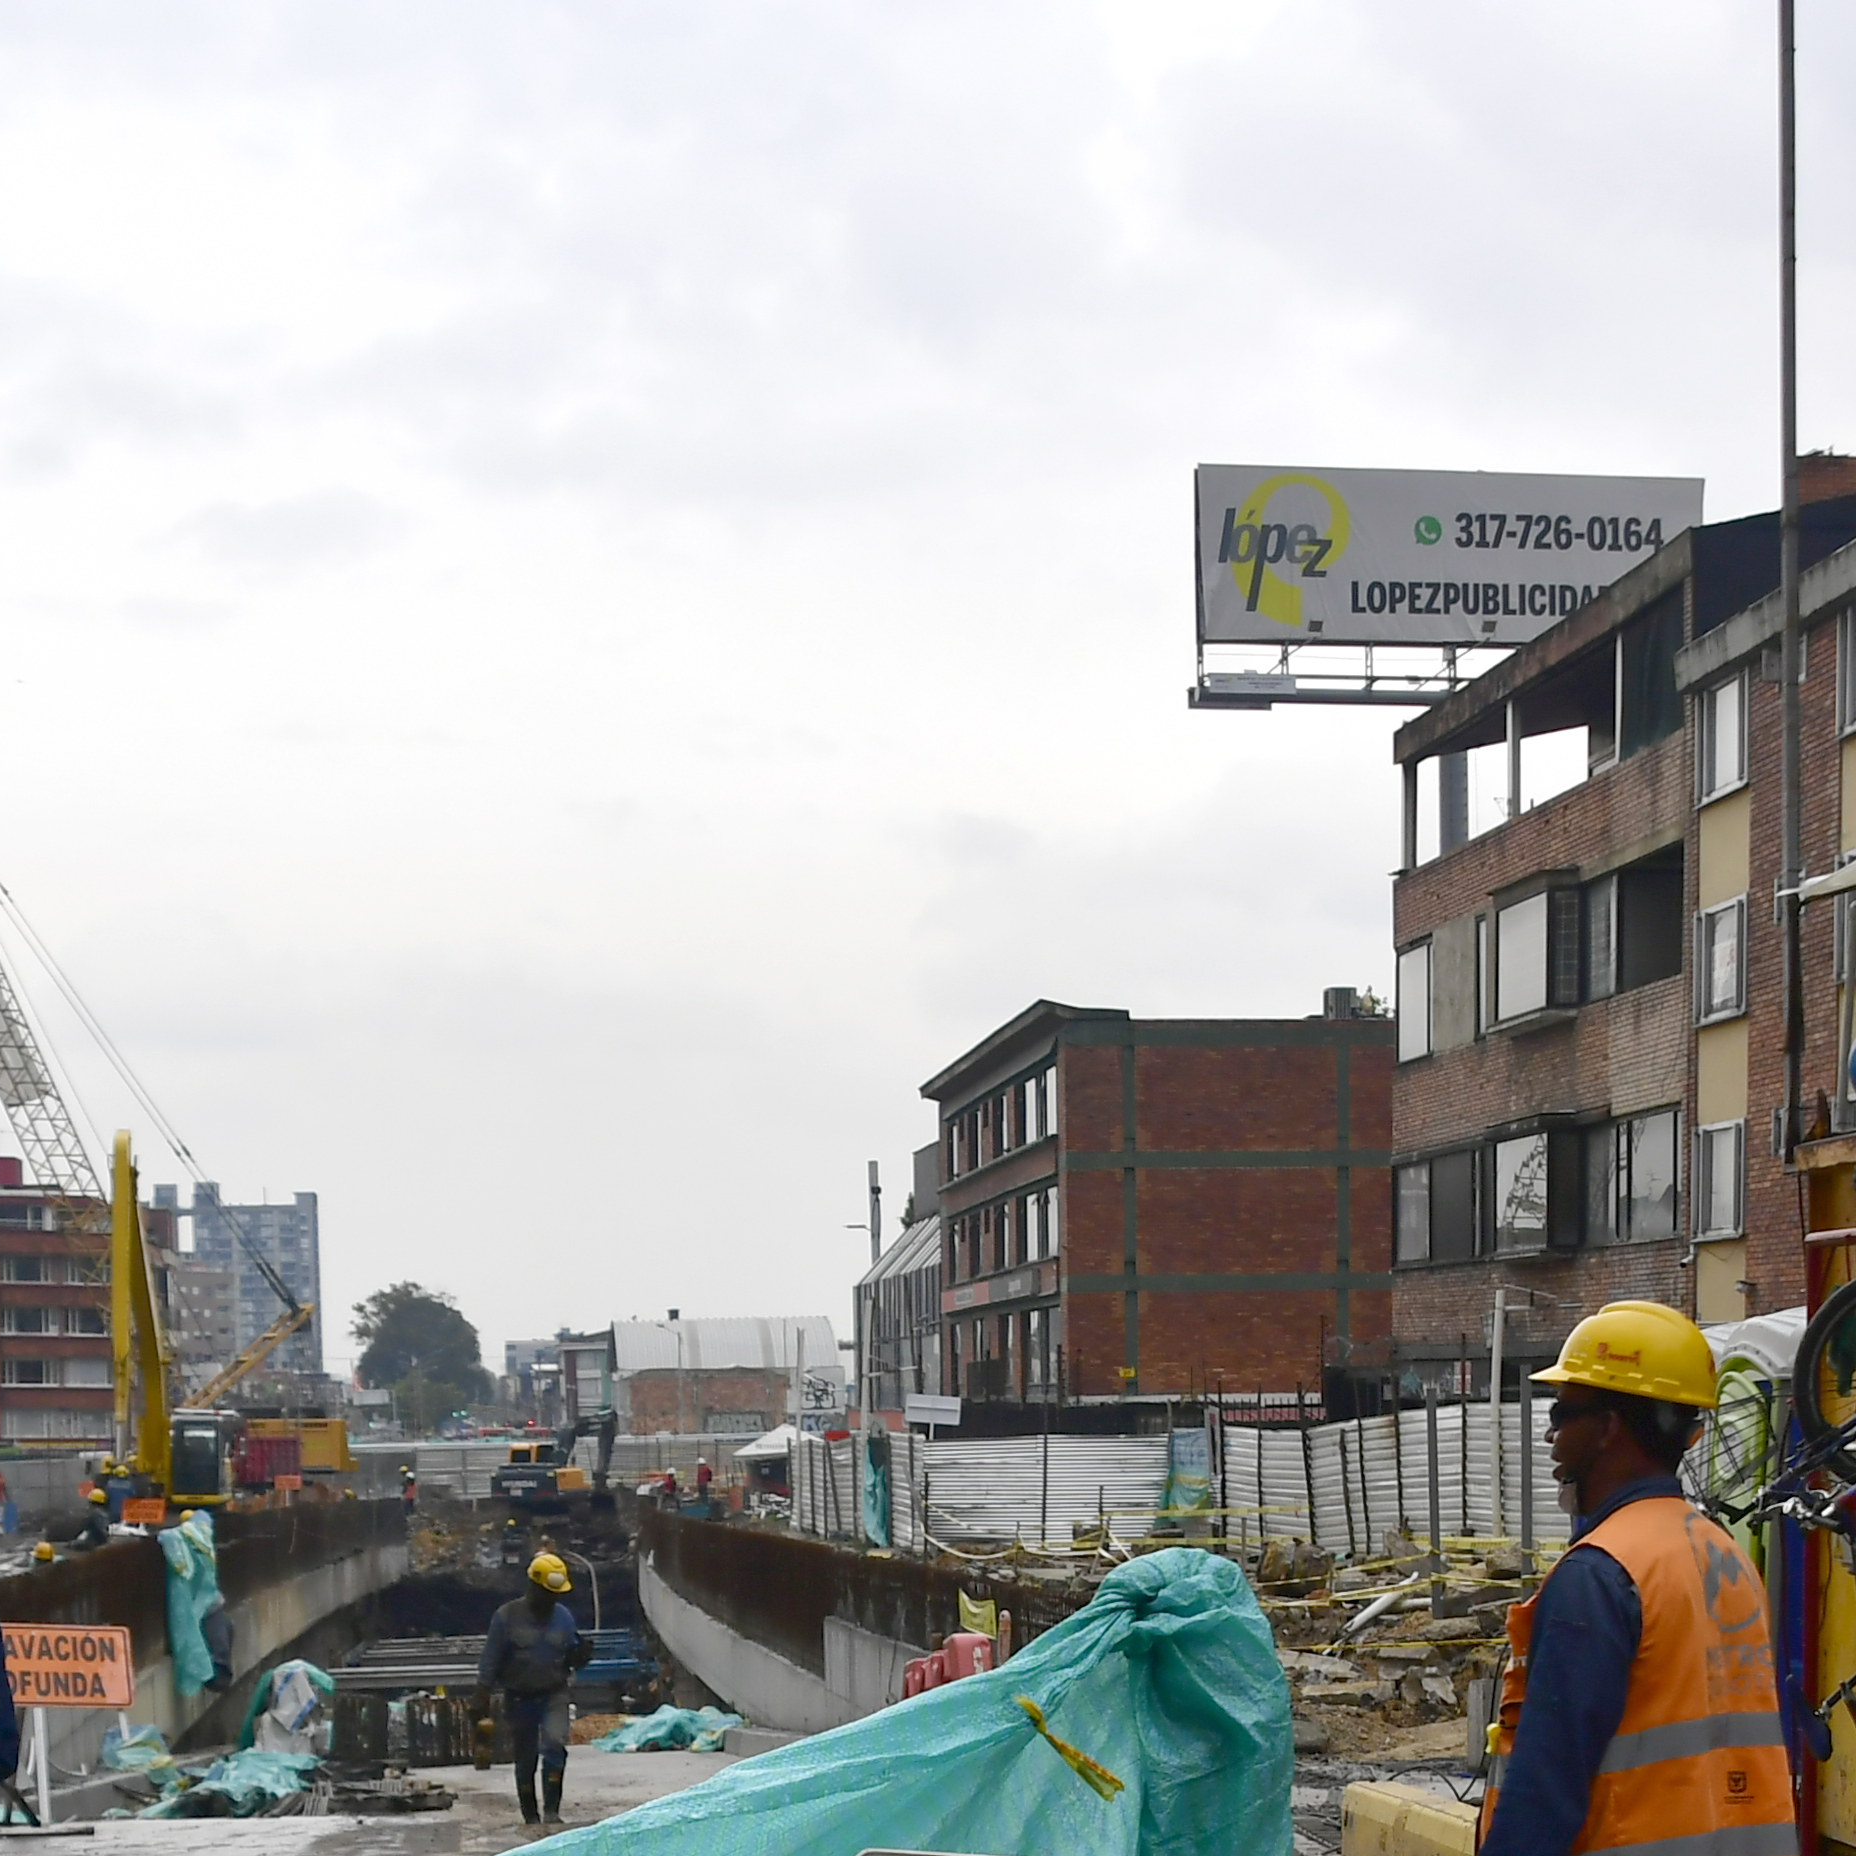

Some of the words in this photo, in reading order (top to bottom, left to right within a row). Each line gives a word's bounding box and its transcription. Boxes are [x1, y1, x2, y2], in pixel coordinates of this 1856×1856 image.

[1455, 512, 1664, 553] 317-726-0164
[1218, 508, 1333, 612] lópez
[1351, 580, 1611, 616] LOPEZPUBLICIDA
[5, 1633, 116, 1663] AVACIÓN
[10, 1671, 107, 1698] OFUNDA
